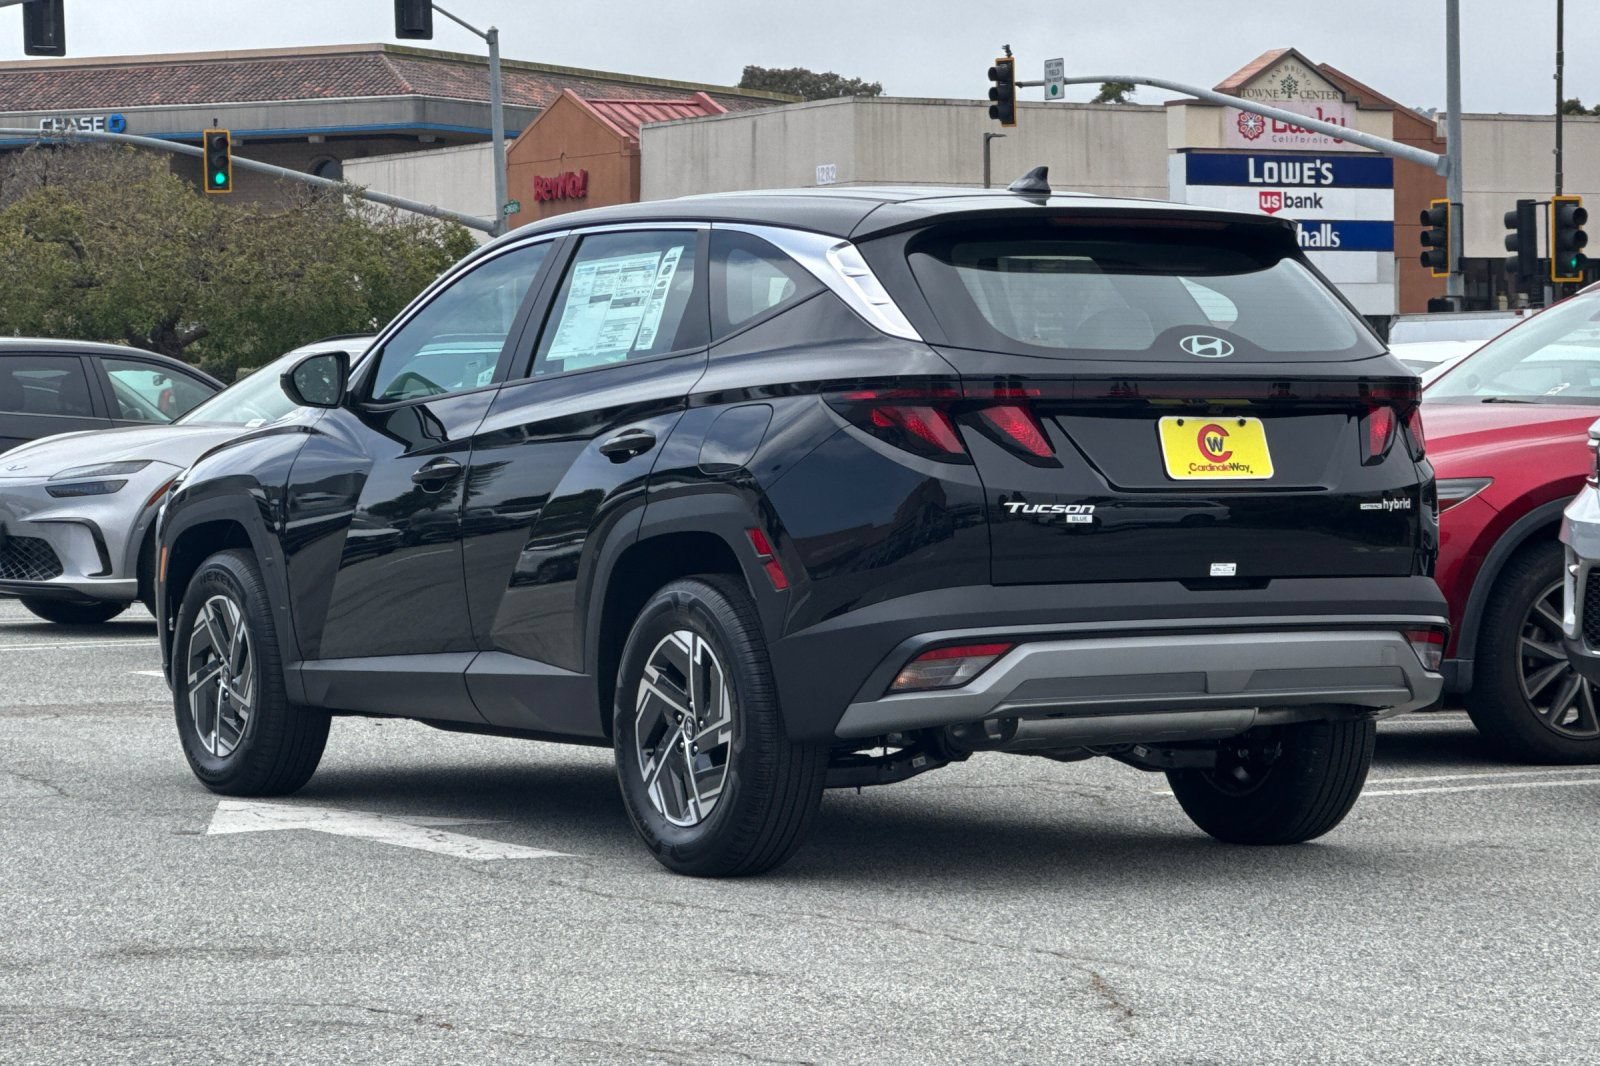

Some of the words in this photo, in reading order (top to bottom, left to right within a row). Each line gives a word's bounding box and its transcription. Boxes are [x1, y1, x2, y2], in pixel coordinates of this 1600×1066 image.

[1241, 88, 1279, 99] TOWNE
[1300, 89, 1339, 100] CENTER
[40, 116, 104, 132] CHASE
[1283, 192, 1323, 208] bank
[1383, 498, 1411, 511] hybrid
